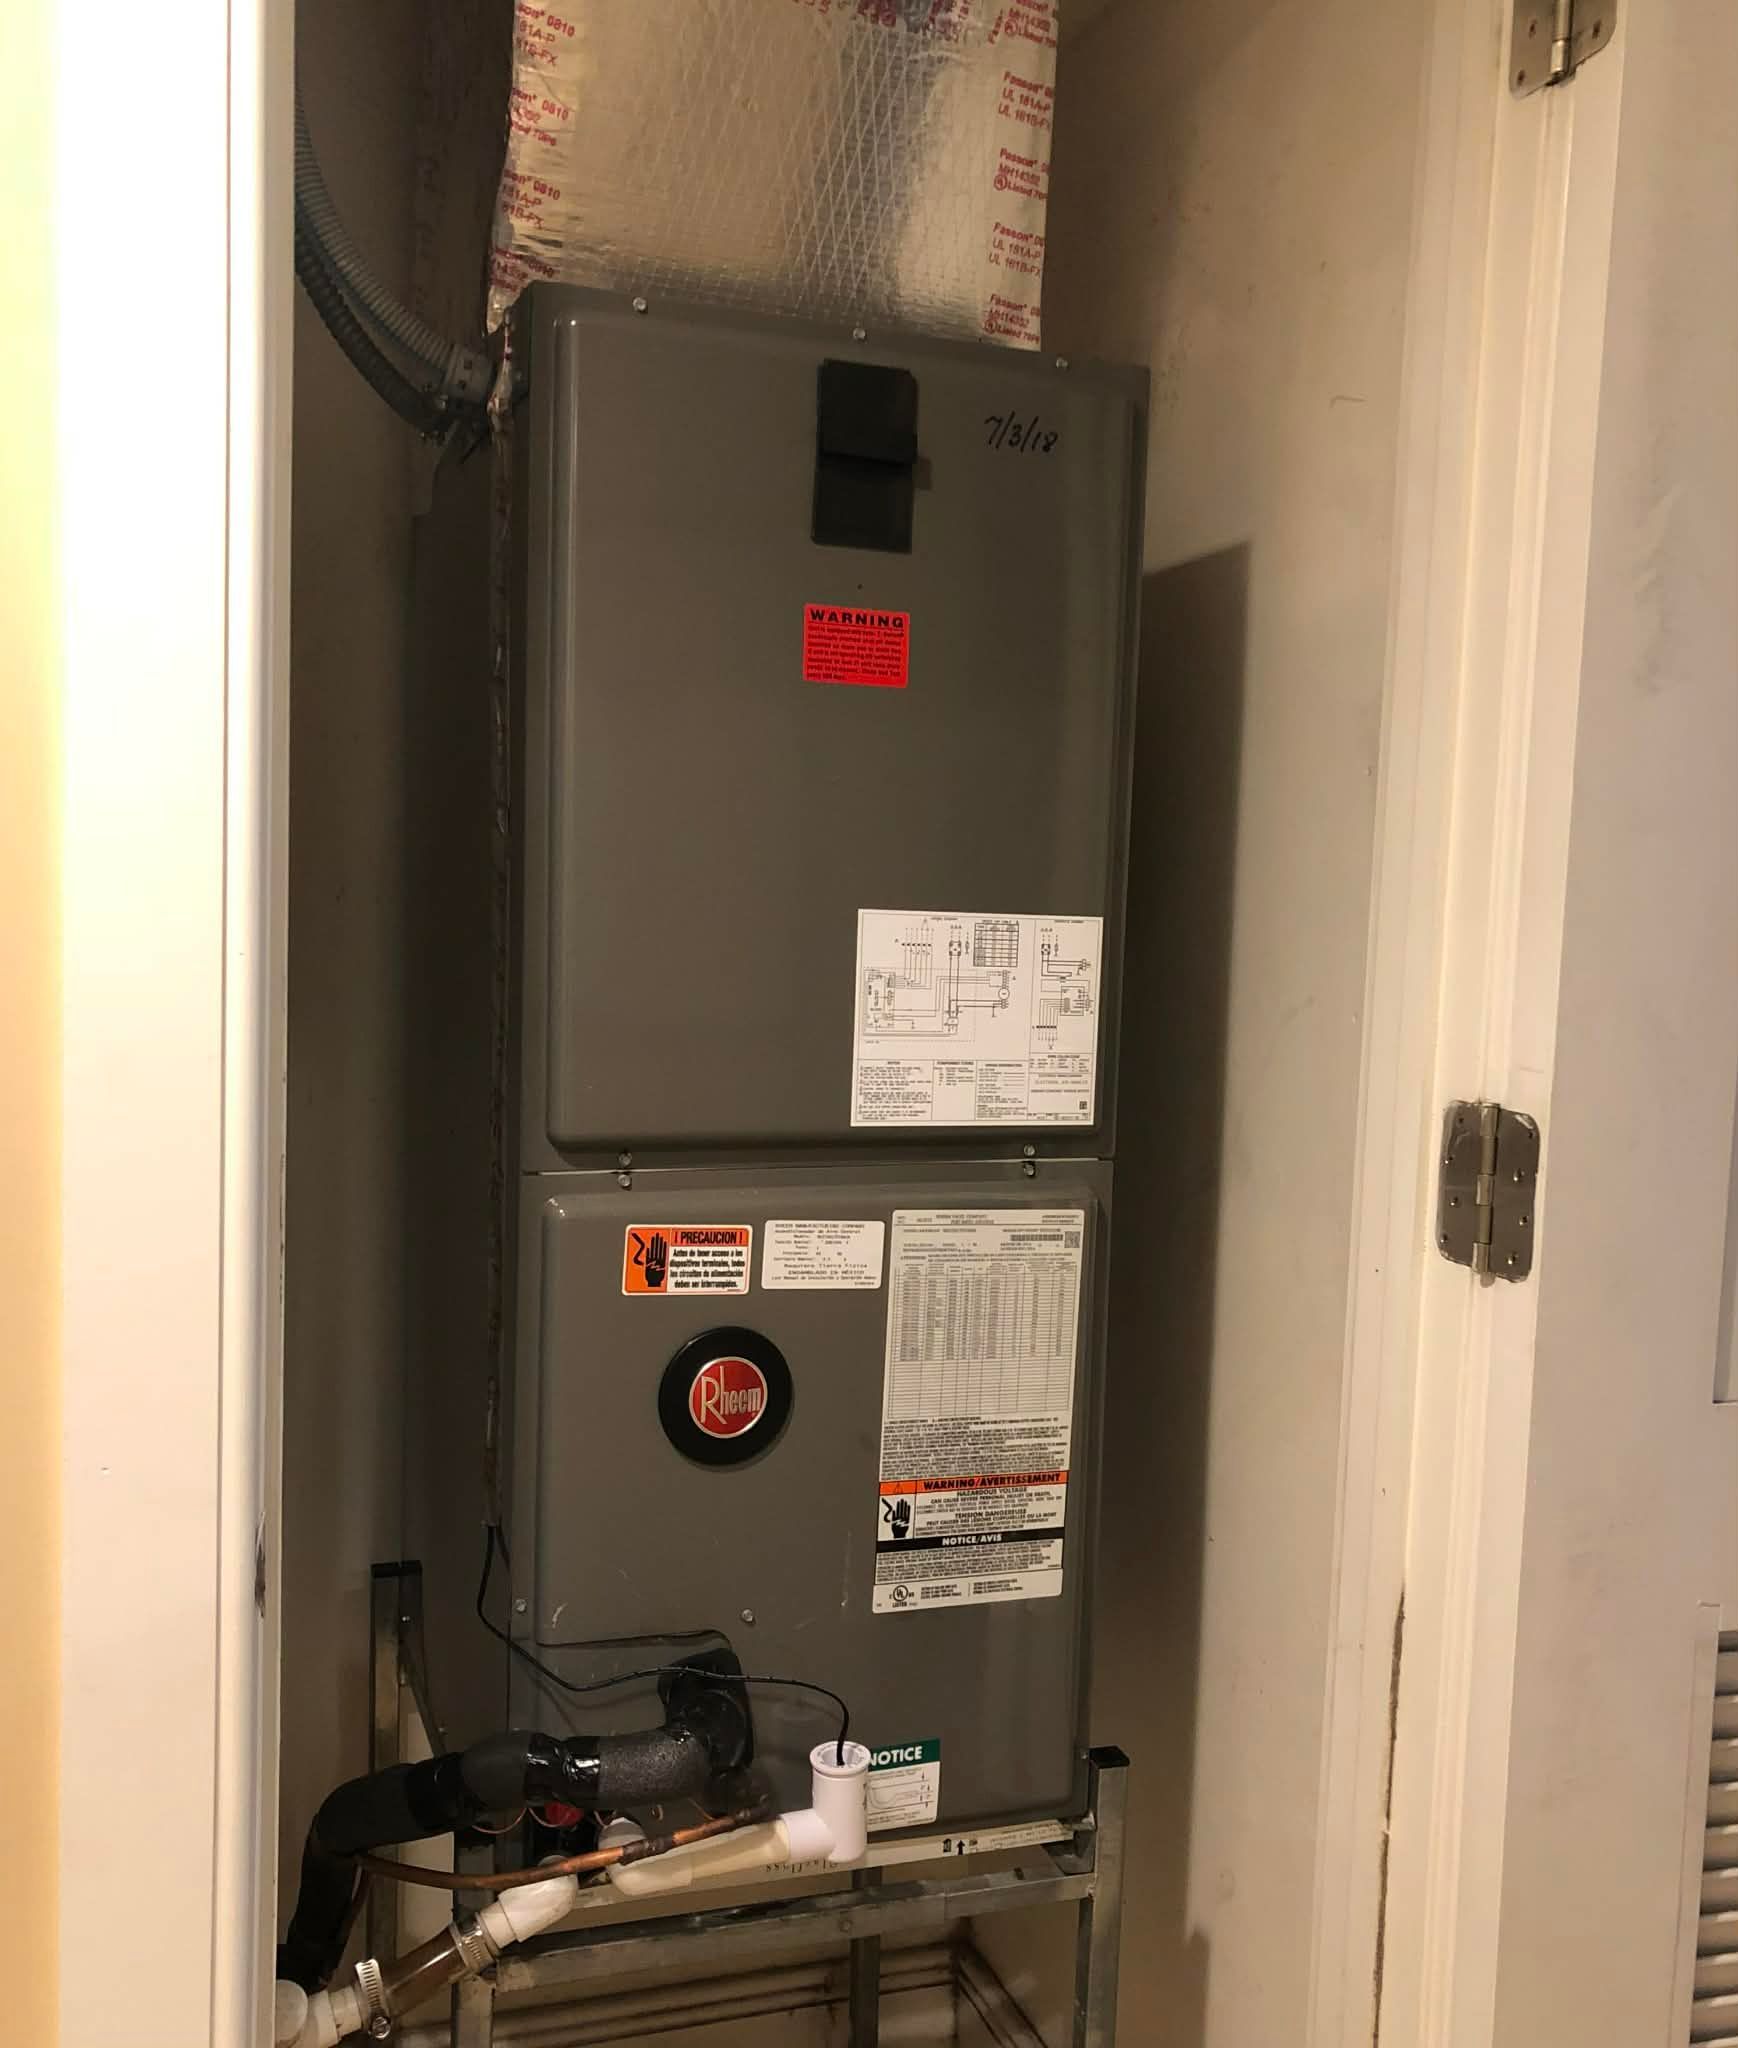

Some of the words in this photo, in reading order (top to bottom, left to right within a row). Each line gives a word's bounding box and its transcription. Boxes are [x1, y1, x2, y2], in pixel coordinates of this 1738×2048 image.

[984, 410, 1060, 454] 7/3/18
[810, 607, 904, 629] WARNING
[680, 1230, 737, 1245] PRECAUCION
[700, 1365, 762, 1425] Rheem
[923, 1473, 1061, 1491] WARNING/AVERTISSEMENT
[941, 1534, 1003, 1547] NOTICE/AVIS
[870, 1745, 923, 1767] NOTICE
